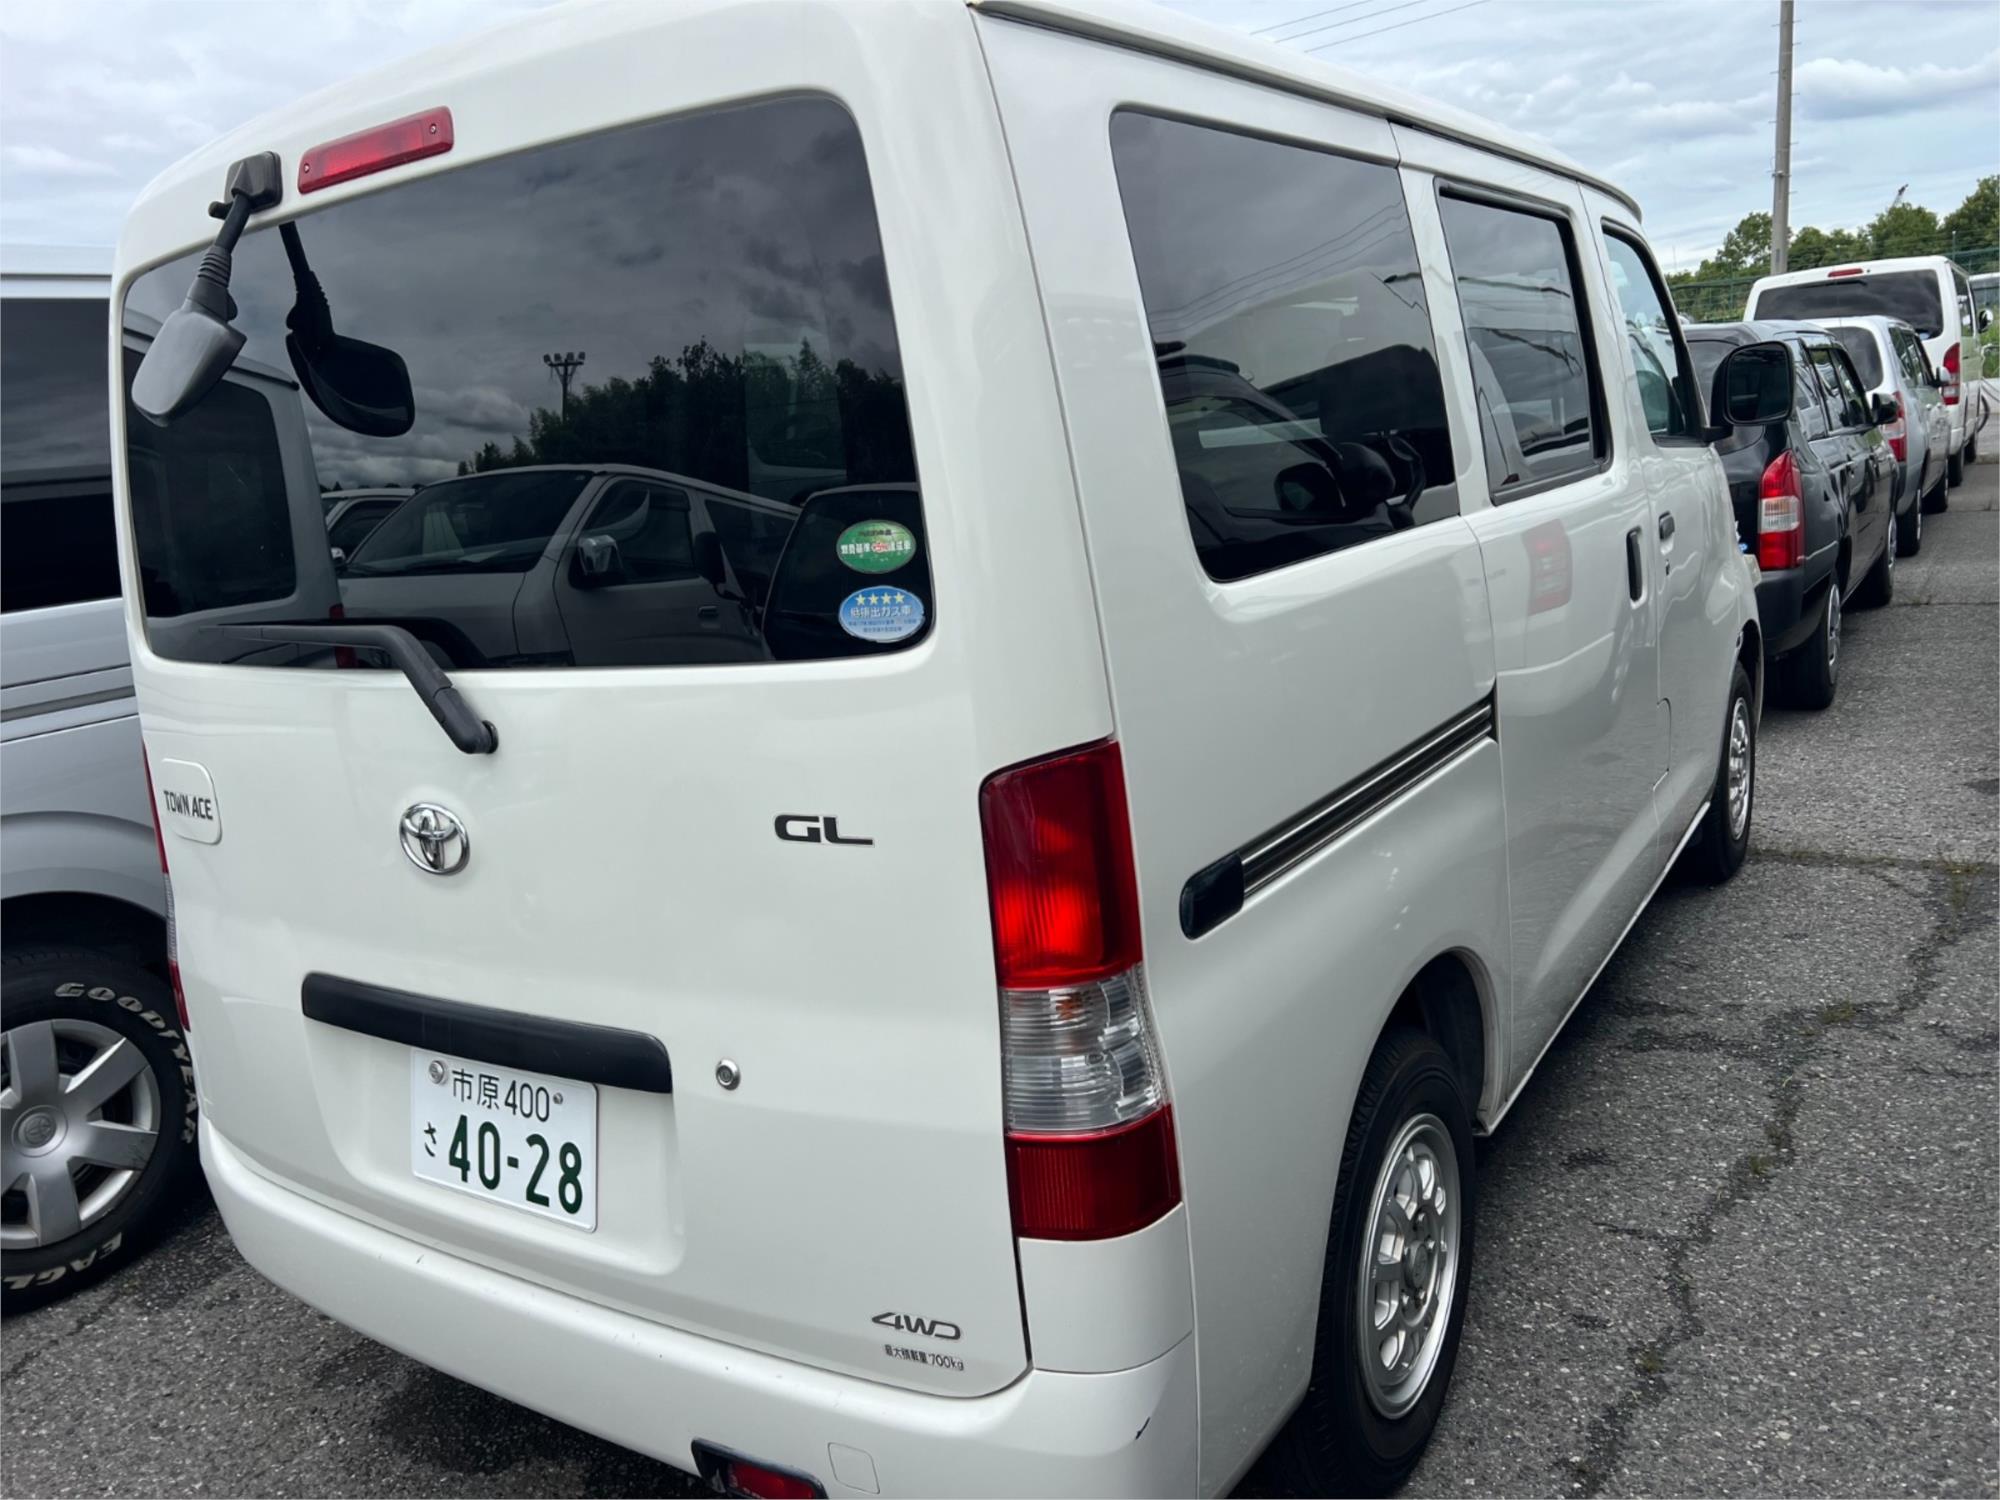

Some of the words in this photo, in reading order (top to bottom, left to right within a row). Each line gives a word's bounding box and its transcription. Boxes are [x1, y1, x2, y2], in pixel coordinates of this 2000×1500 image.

[163, 789, 190, 816] TOWN
[192, 796, 214, 821] ACE
[774, 814, 874, 846] GL
[55, 981, 199, 1145] GOODYEAR
[448, 1114, 583, 1215] 40-28
[871, 1311, 961, 1341] 4WD
